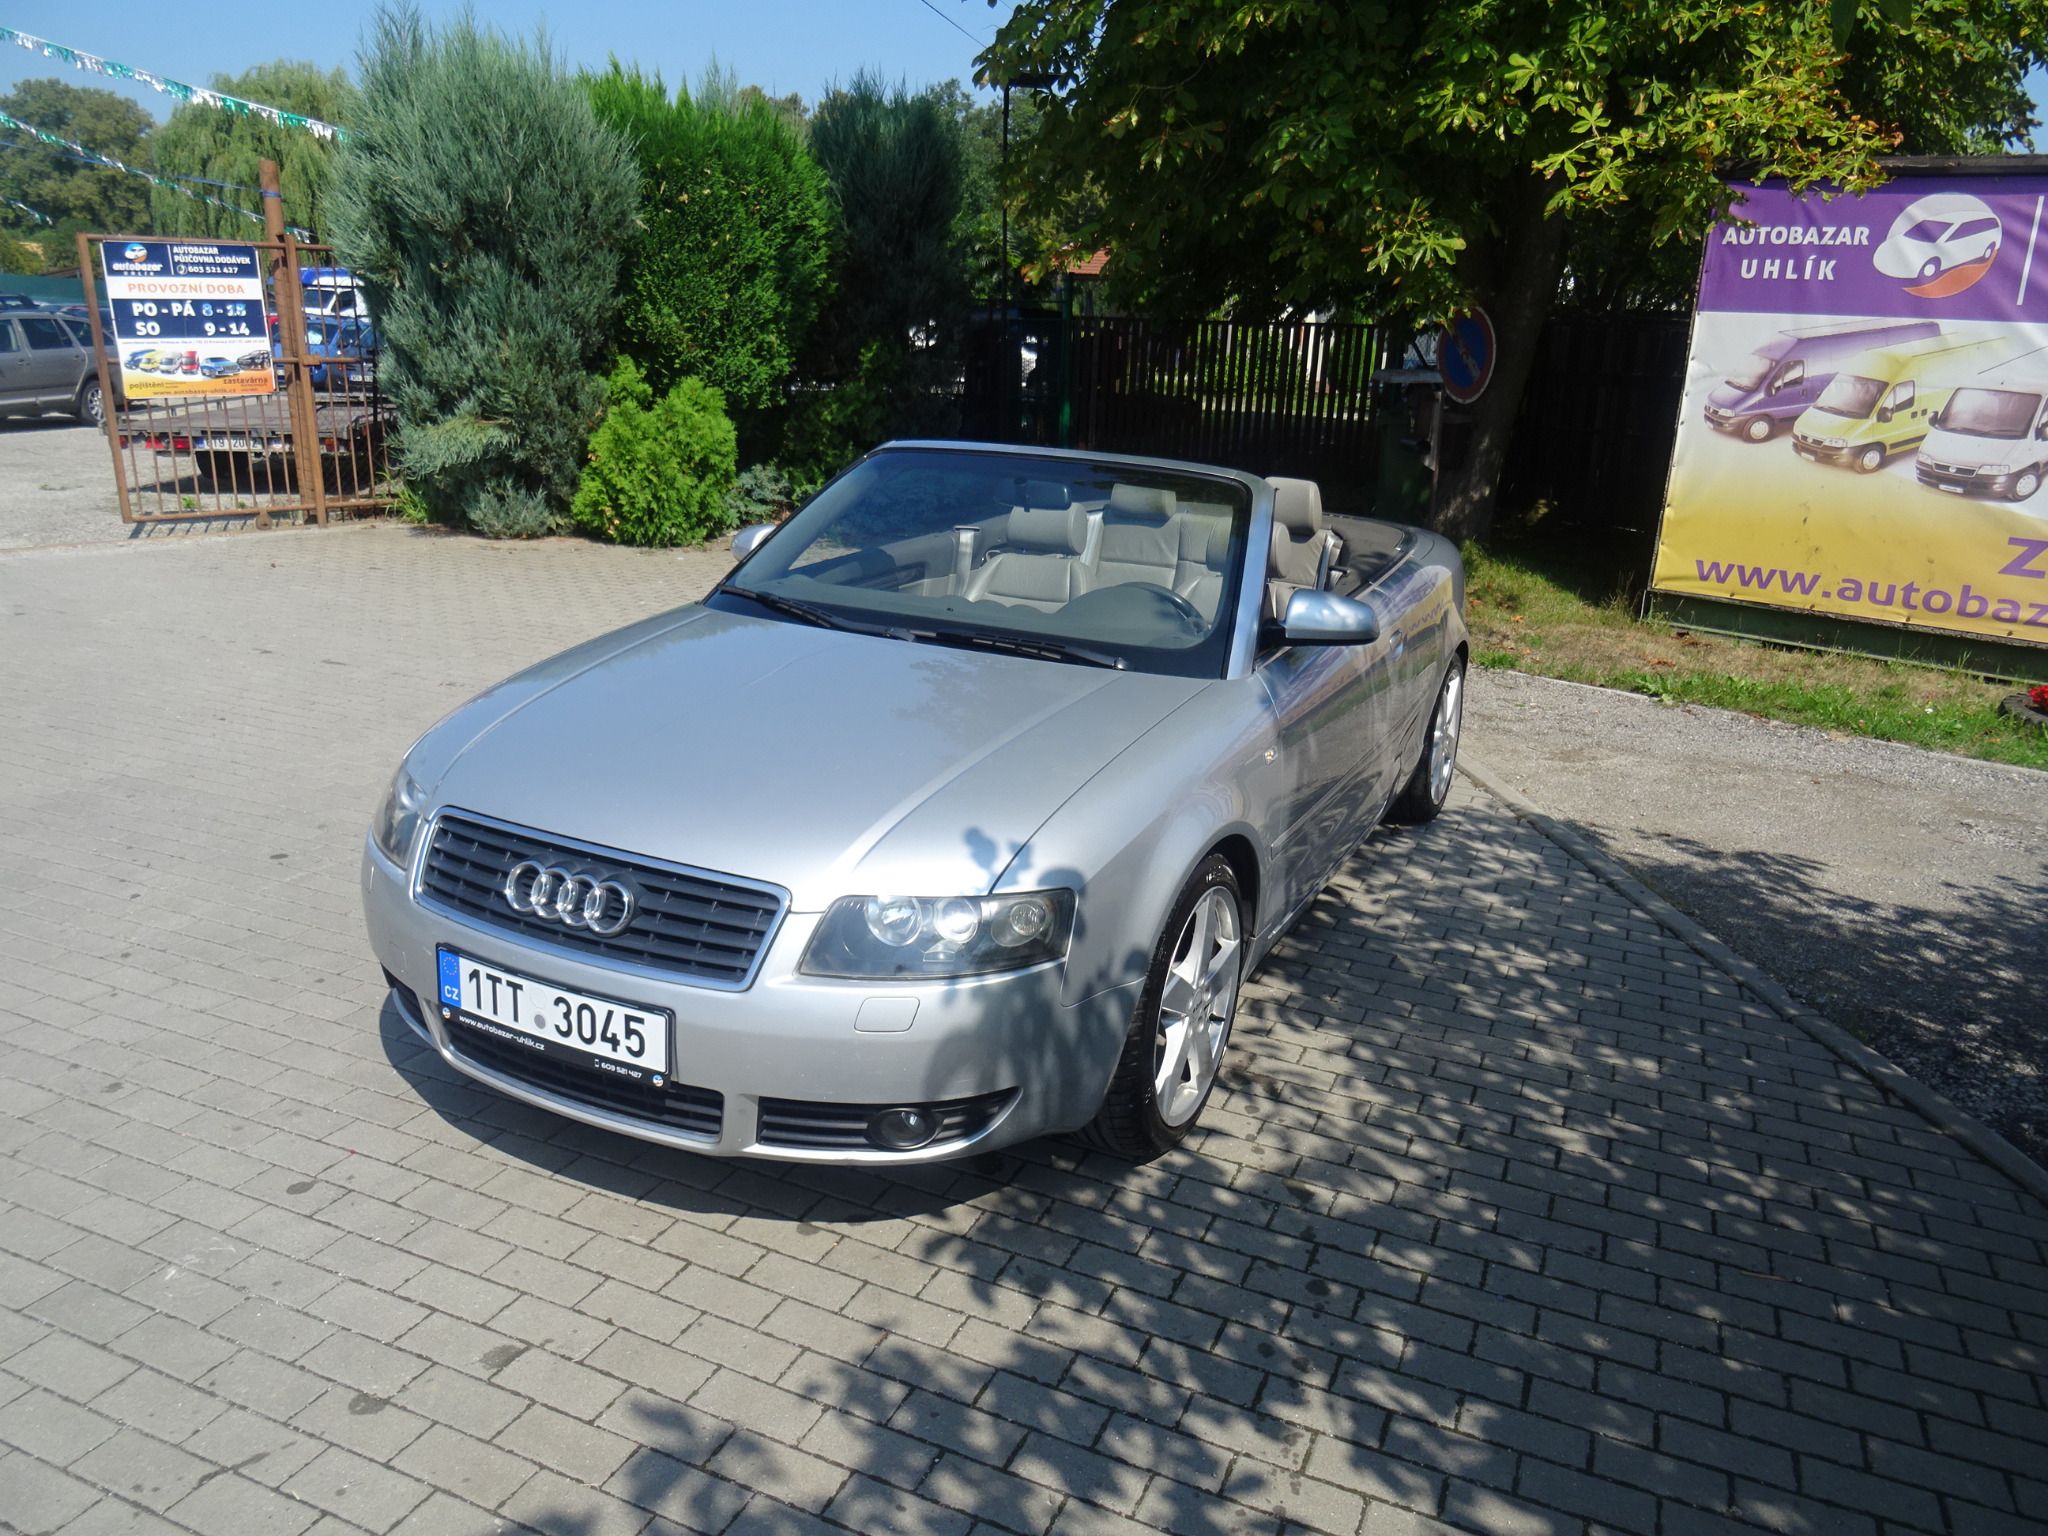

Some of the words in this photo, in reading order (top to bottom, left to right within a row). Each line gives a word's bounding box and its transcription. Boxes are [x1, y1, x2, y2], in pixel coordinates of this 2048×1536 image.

[1722, 226, 1869, 246] AUTOBAZAR
[173, 246, 219, 254] AUTOBAZAR
[173, 253, 214, 264] PŮJČOVNA
[215, 255, 251, 265] DODÁVEK
[188, 265, 204, 273] 603
[206, 266, 221, 274] 521
[223, 266, 238, 274] 427
[1741, 255, 1836, 281] UHLÍK
[128, 281, 202, 294] PROVOZNÍ
[206, 283, 245, 294] DOBA
[131, 302, 158, 317] PO
[171, 300, 196, 317] PÁ
[202, 303, 213, 317] 8
[135, 321, 161, 336] SO
[204, 322, 216, 336] 9
[228, 322, 250, 336] 14
[1696, 559, 2048, 628] www.autobaz
[444, 985, 460, 1001] CZ
[469, 968, 524, 1024] 1TT
[554, 996, 645, 1058] 3045
[459, 1015, 545, 1051] www.autobazar-uhlik.cz
[601, 1062, 616, 1072] 603
[629, 1069, 642, 1079] 427
